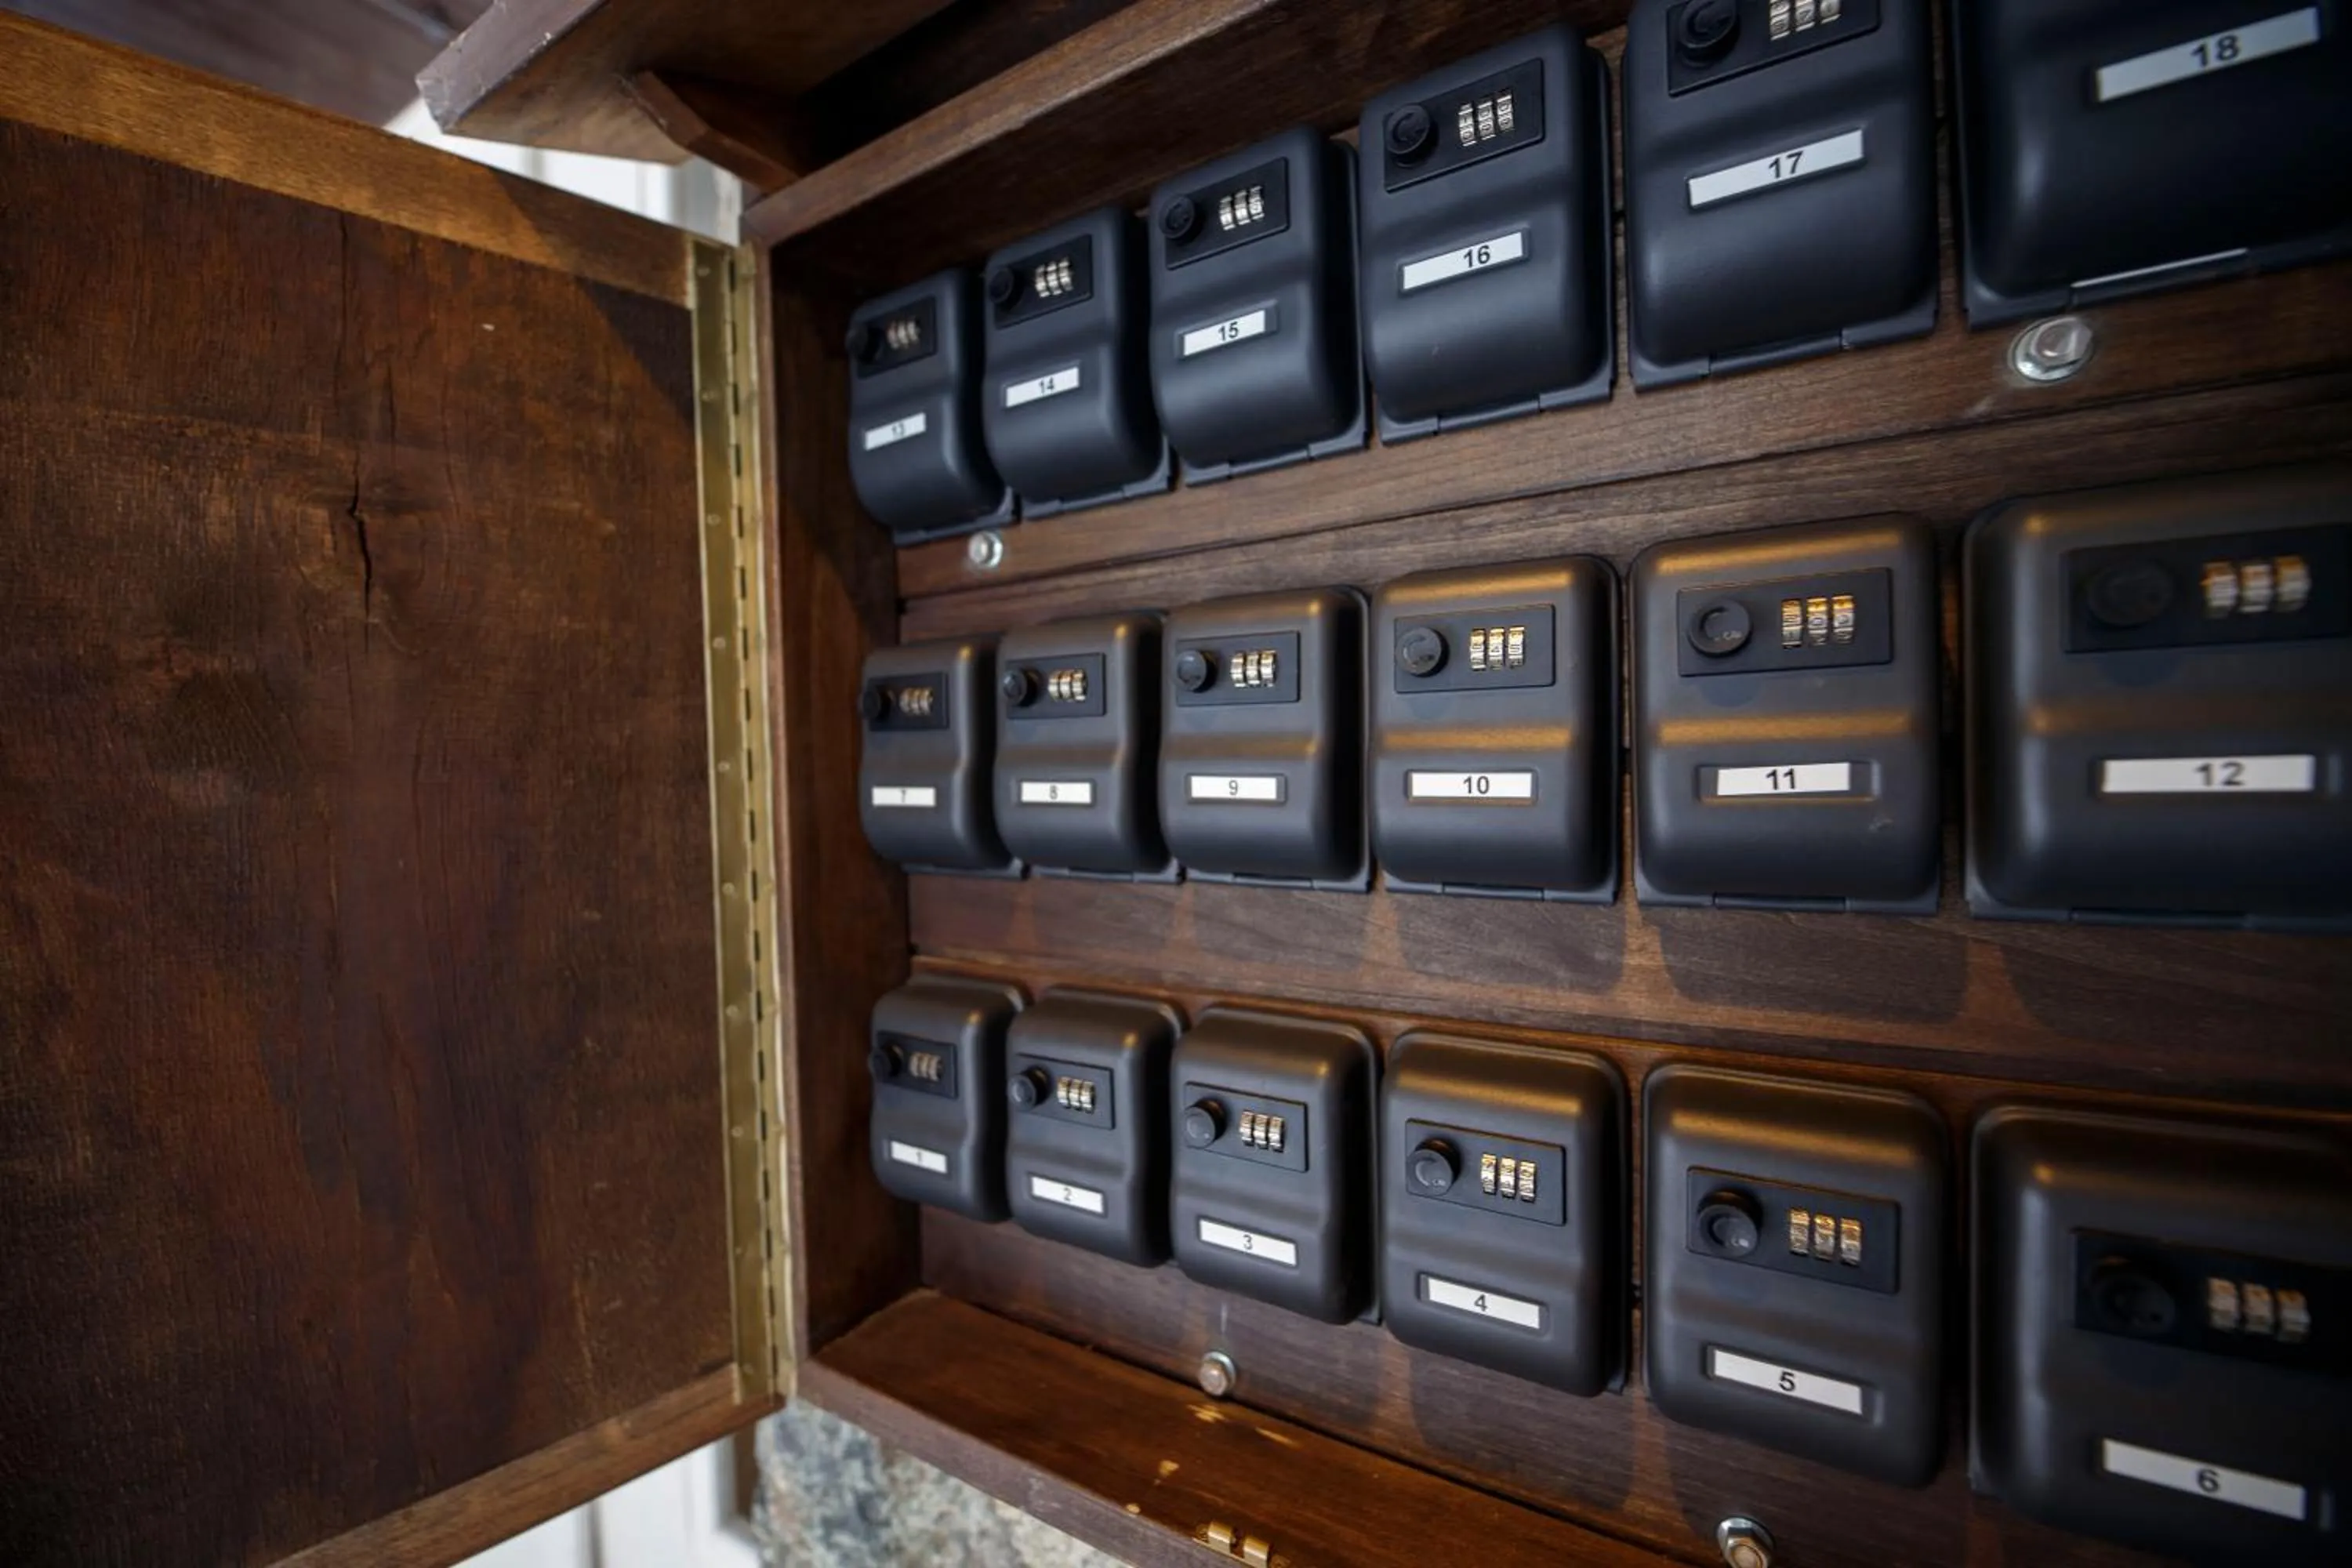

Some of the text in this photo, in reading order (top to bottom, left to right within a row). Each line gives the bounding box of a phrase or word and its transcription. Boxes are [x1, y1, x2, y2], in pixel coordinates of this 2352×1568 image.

[2190, 34, 2240, 68] 18
[1768, 151, 1804, 179] 17
[1463, 245, 1490, 268] 16
[1218, 321, 1239, 341] 15
[1039, 377, 1054, 395] 14
[1463, 775, 1490, 793] 10
[1766, 768, 1796, 790] 11
[2194, 762, 2245, 786] 12
[1049, 785, 1058, 800] 8
[1229, 780, 1238, 795] 9
[1063, 1188, 1072, 1201] 2
[1243, 1234, 1252, 1250] 3
[1474, 1294, 1487, 1312] 4
[1778, 1371, 1795, 1392] 5
[2198, 1468, 2221, 1494] 6
